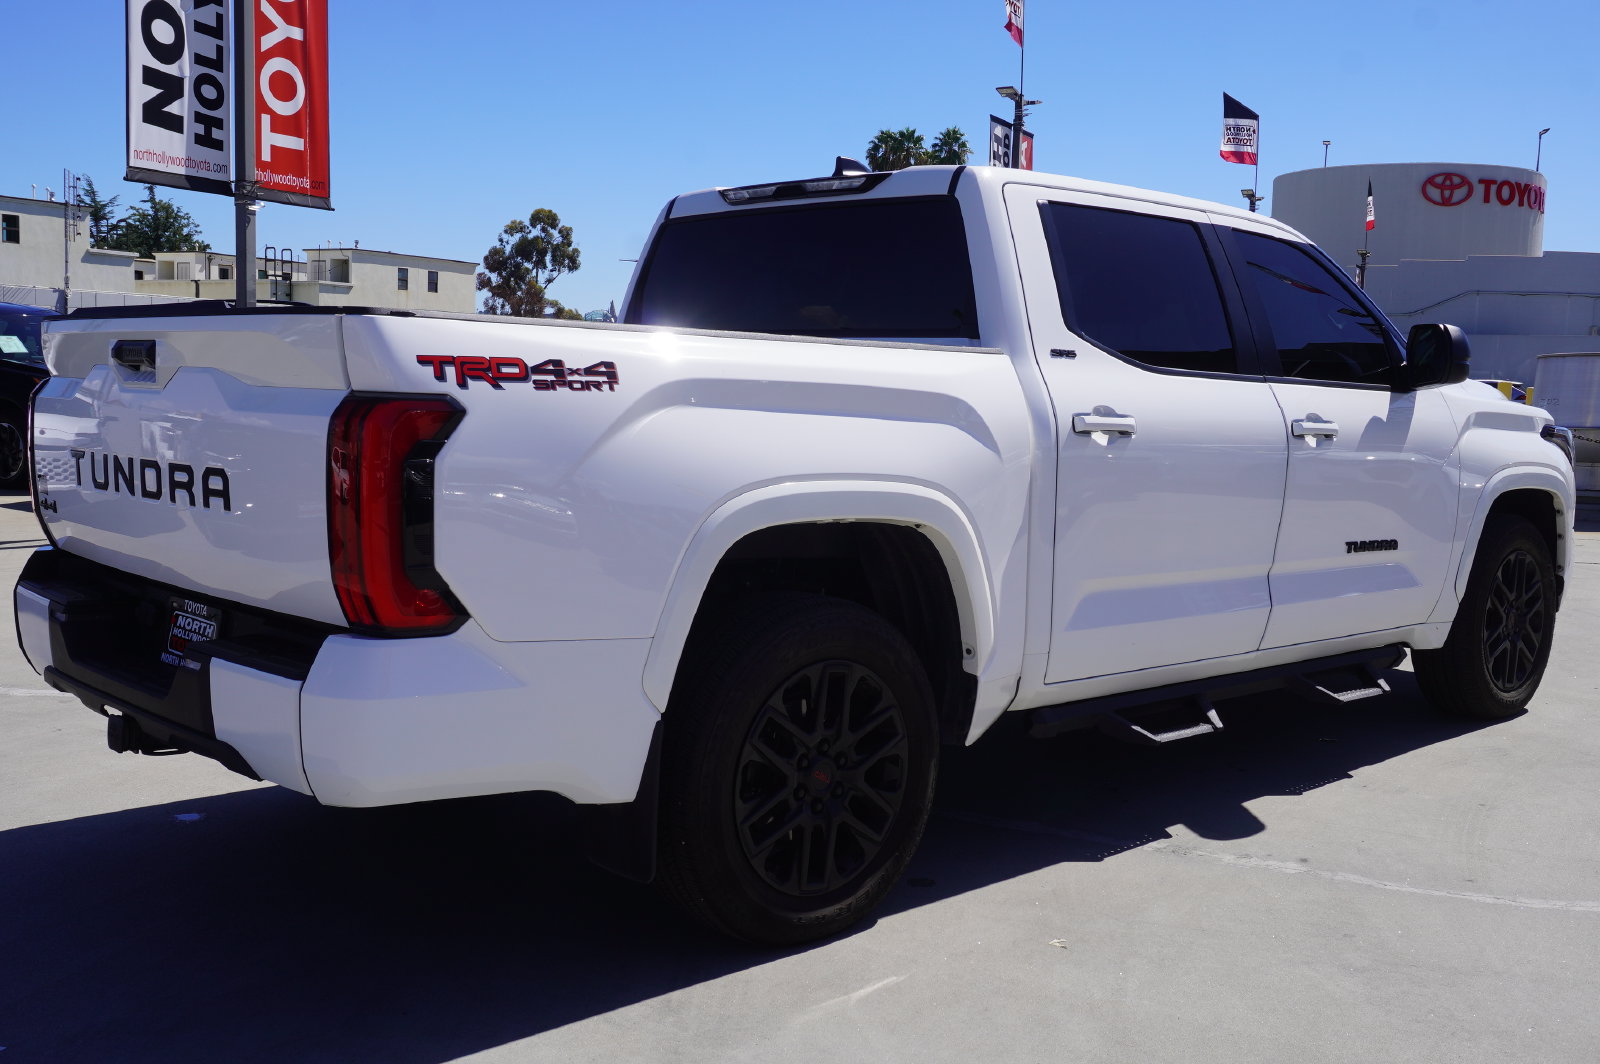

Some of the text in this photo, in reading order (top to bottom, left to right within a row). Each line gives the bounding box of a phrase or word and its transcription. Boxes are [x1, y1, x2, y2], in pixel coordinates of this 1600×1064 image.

[260, 0, 306, 162] TOY
[133, 149, 228, 175] northhollywoodtoyota.com
[416, 354, 531, 390] TRD
[532, 379, 619, 392] SPORT
[71, 450, 231, 512] TUNDRA
[1345, 539, 1399, 554] TUNDRA
[184, 599, 208, 616] TOYOTA
[177, 616, 214, 637] NORTH
